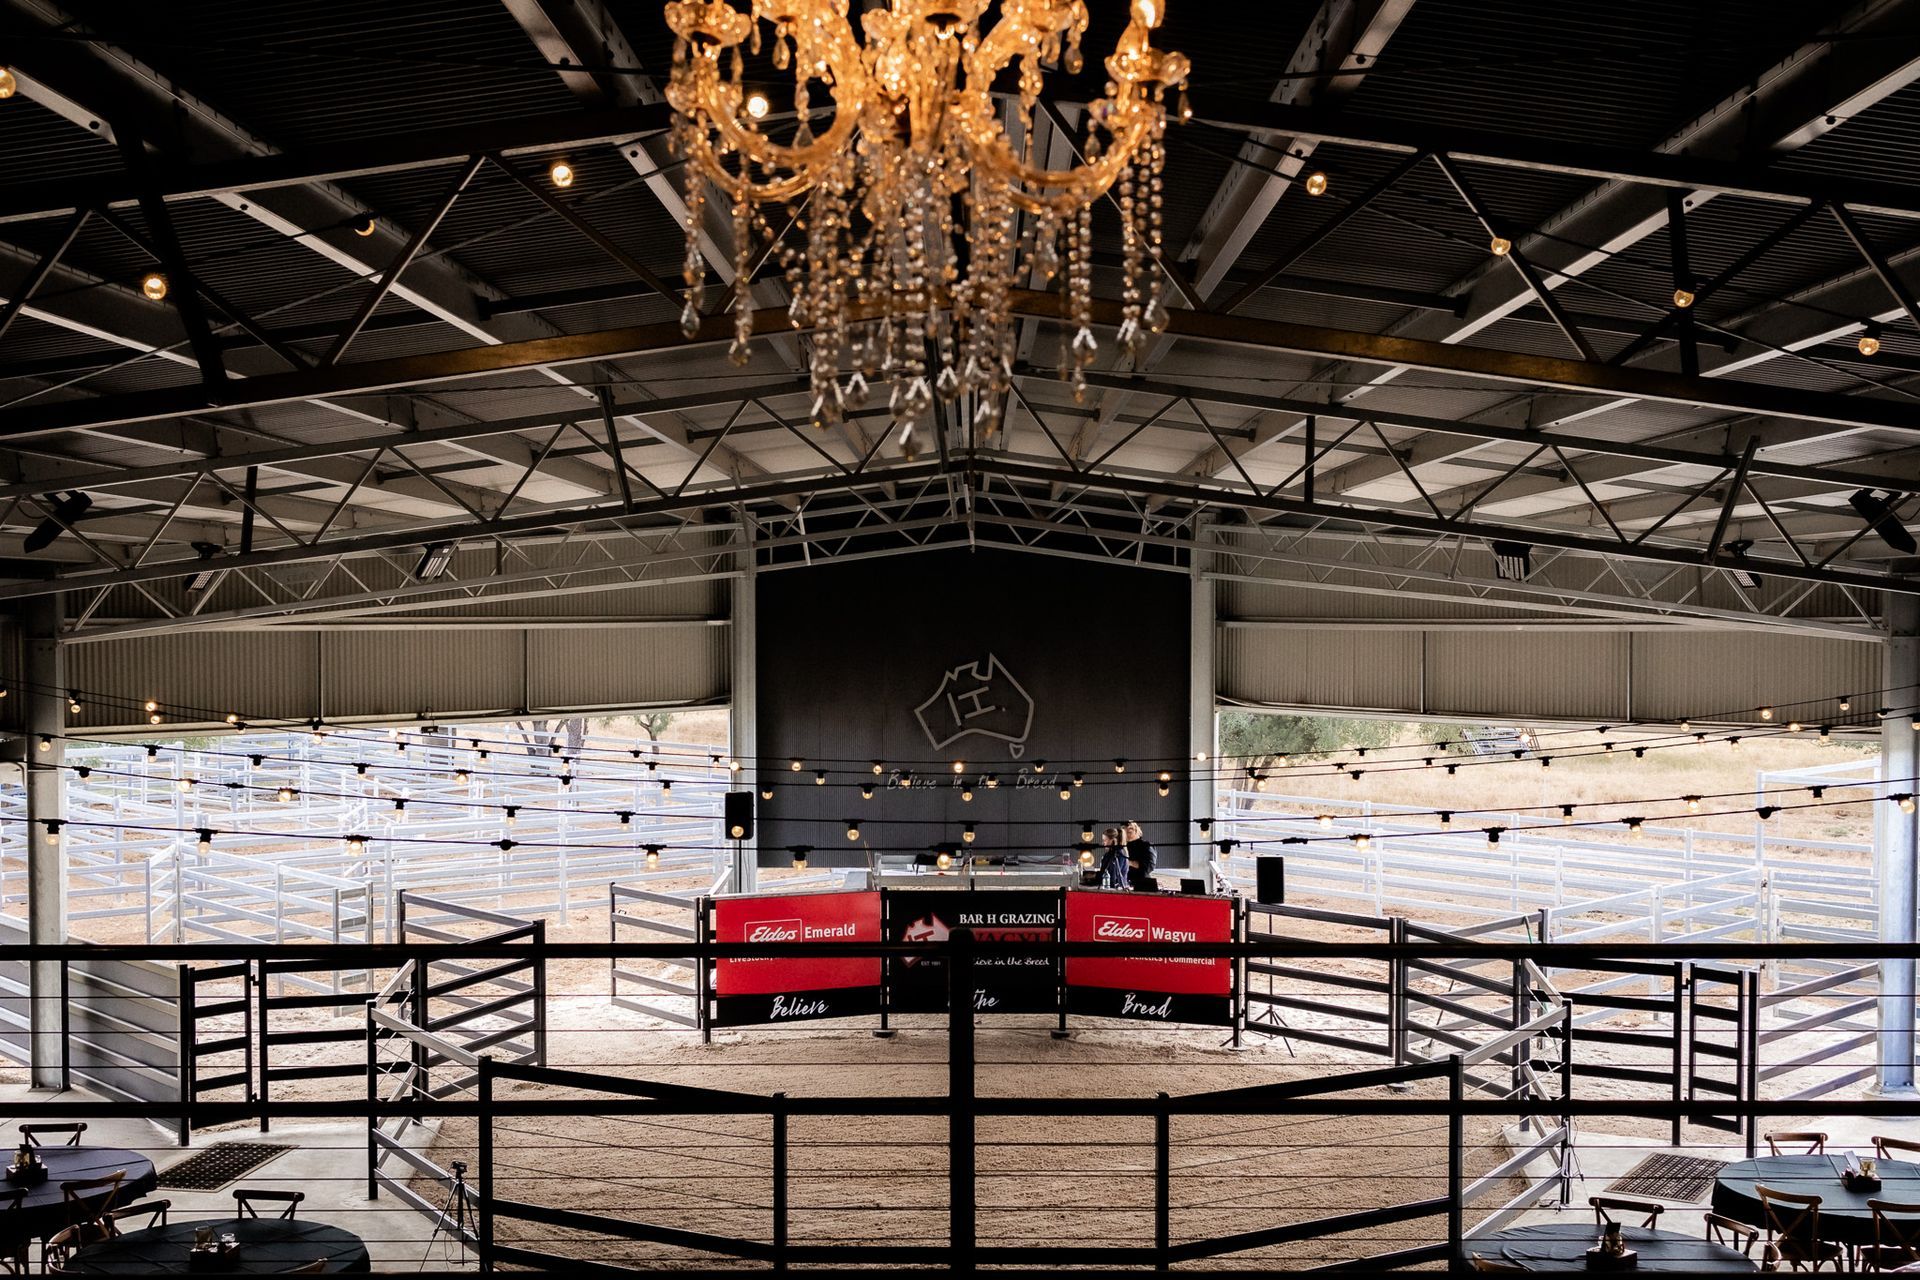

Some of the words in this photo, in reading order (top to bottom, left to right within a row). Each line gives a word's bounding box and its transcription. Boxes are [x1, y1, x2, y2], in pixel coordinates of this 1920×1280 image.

[959, 914, 984, 924] BAR
[987, 914, 996, 924] H
[999, 914, 1055, 924] GRAZING
[749, 926, 799, 943] Elders
[805, 923, 856, 939] Emerald
[1098, 920, 1146, 939] Elders
[1151, 927, 1197, 943] Wagyu
[994, 958, 1005, 966] in
[1007, 957, 1023, 966] the
[1024, 957, 1050, 966] Breed
[769, 995, 829, 1020] Believe
[1121, 992, 1173, 1019] Breed
